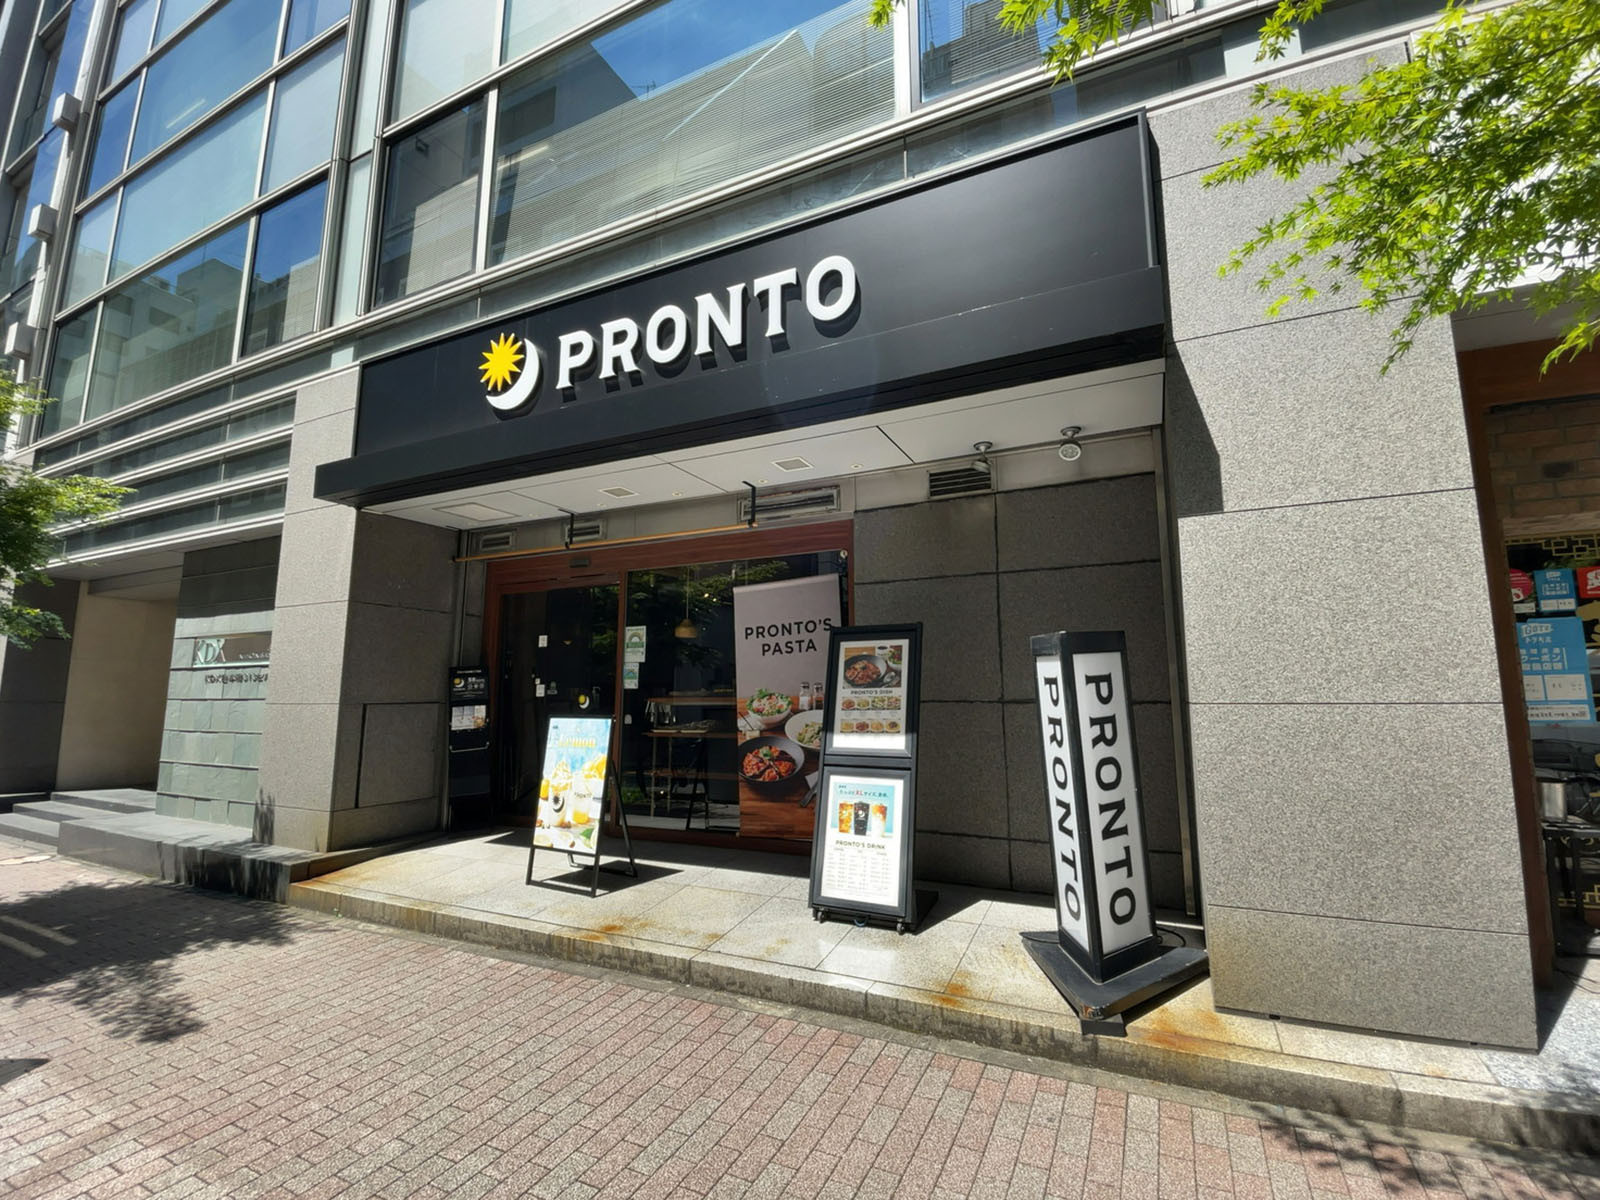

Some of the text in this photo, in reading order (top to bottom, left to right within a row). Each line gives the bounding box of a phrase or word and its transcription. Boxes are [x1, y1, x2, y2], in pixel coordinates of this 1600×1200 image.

[555, 255, 857, 390] PRONTO
[744, 618, 833, 640] PRONTO'S
[761, 639, 818, 656] PASTA
[1043, 675, 1081, 922] PRONTO
[1085, 672, 1136, 925] PRONTO
[835, 839, 865, 849] PRONTO'S
